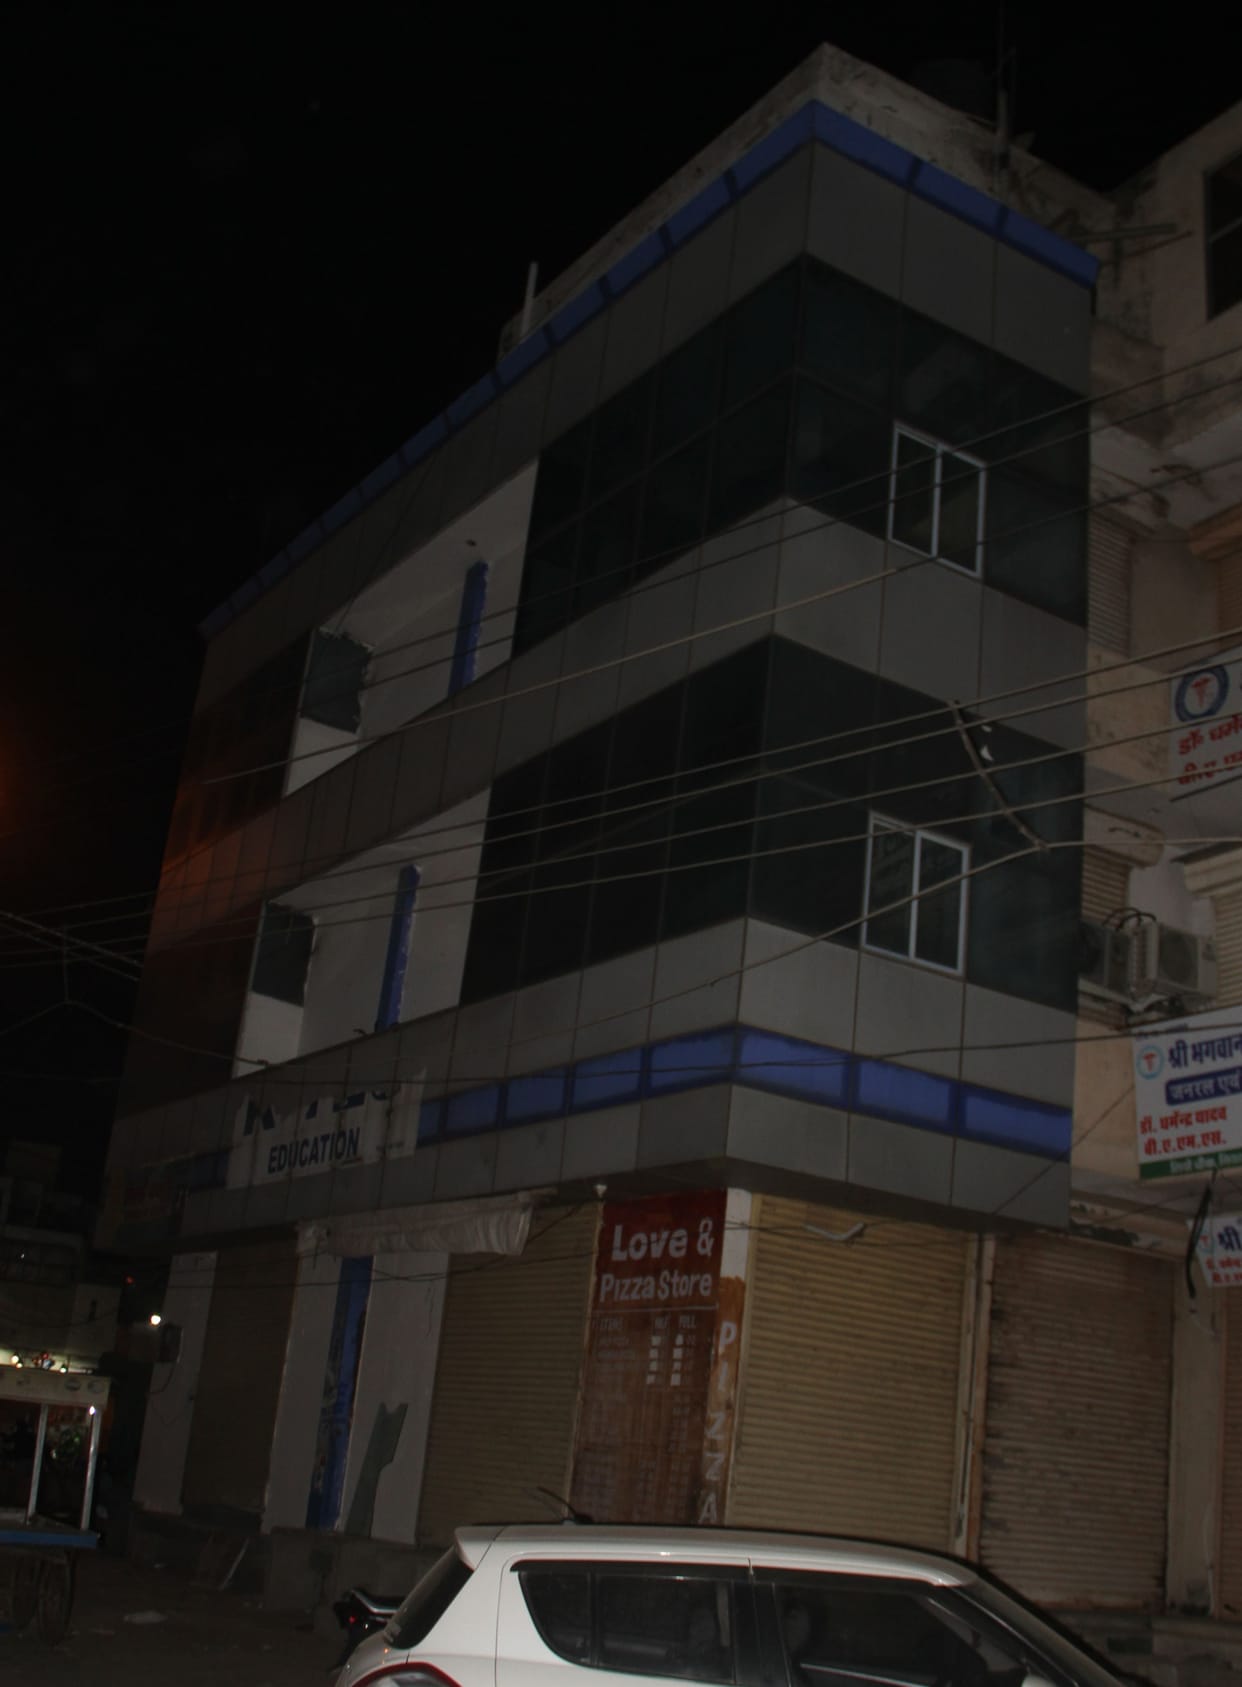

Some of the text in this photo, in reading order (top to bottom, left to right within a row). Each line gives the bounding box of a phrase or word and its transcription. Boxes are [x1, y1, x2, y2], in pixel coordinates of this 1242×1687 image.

[1169, 1039, 1188, 1069] श्री
[1194, 1105, 1227, 1124] यादव
[268, 1127, 361, 1175] EDUCATION
[611, 1216, 715, 1262] Love &
[599, 1269, 713, 1303] Pizza Store
[698, 1320, 738, 1525] PIZZA
